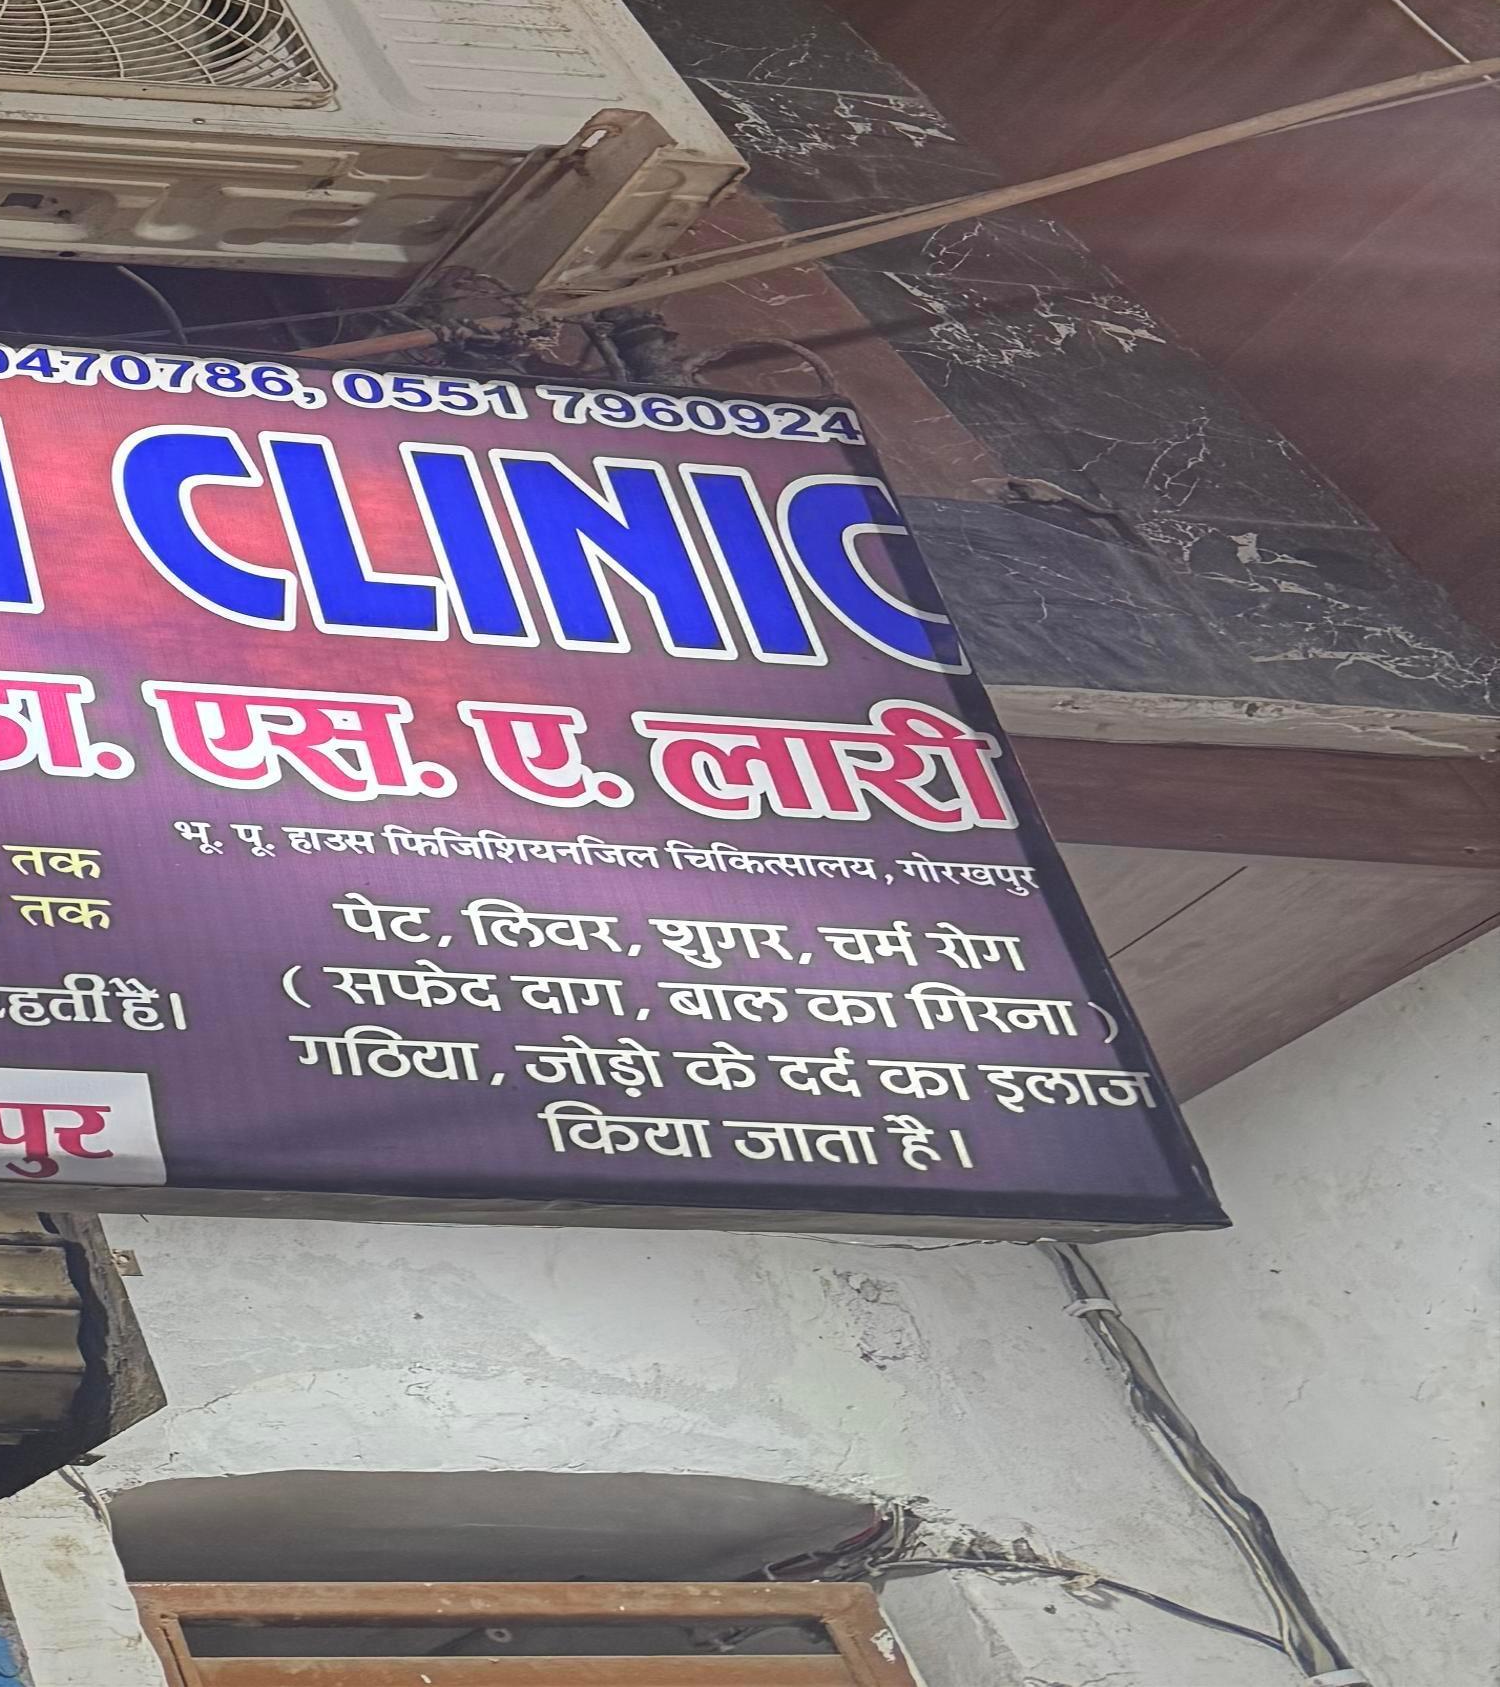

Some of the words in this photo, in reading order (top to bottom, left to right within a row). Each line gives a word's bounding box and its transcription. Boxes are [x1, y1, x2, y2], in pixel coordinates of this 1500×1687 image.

[537, 385, 866, 445] 7960924
[111, 424, 972, 675] CLINIC
[141, 679, 458, 803] एस.
[459, 700, 634, 810] ए.
[635, 699, 1019, 831] लारी
[3, 841, 103, 881] तक
[174, 820, 224, 856] भू.
[230, 823, 276, 858] पू.
[282, 825, 375, 855] हाउस
[896, 852, 1041, 897] गोरखपुर
[11, 893, 112, 931] तक
[332, 892, 454, 948] पेट,
[461, 897, 642, 957] लिवर,
[648, 916, 812, 969] शुगर,
[817, 919, 920, 968] चर्म
[925, 921, 1027, 972] रोग
[323, 958, 502, 1013] सफेद
[510, 973, 651, 1022] दाग,
[657, 981, 788, 1024] बाल
[795, 987, 898, 1029] का
[905, 981, 1079, 1037] गिरना
[288, 1024, 505, 1086] गठिया,
[672, 1040, 757, 1091] के
[768, 1046, 863, 1098] दर्द
[867, 1058, 971, 1101] का
[977, 1063, 1157, 1113] इलाज
[537, 1099, 712, 1158] किया
[721, 1119, 880, 1165] जाता
